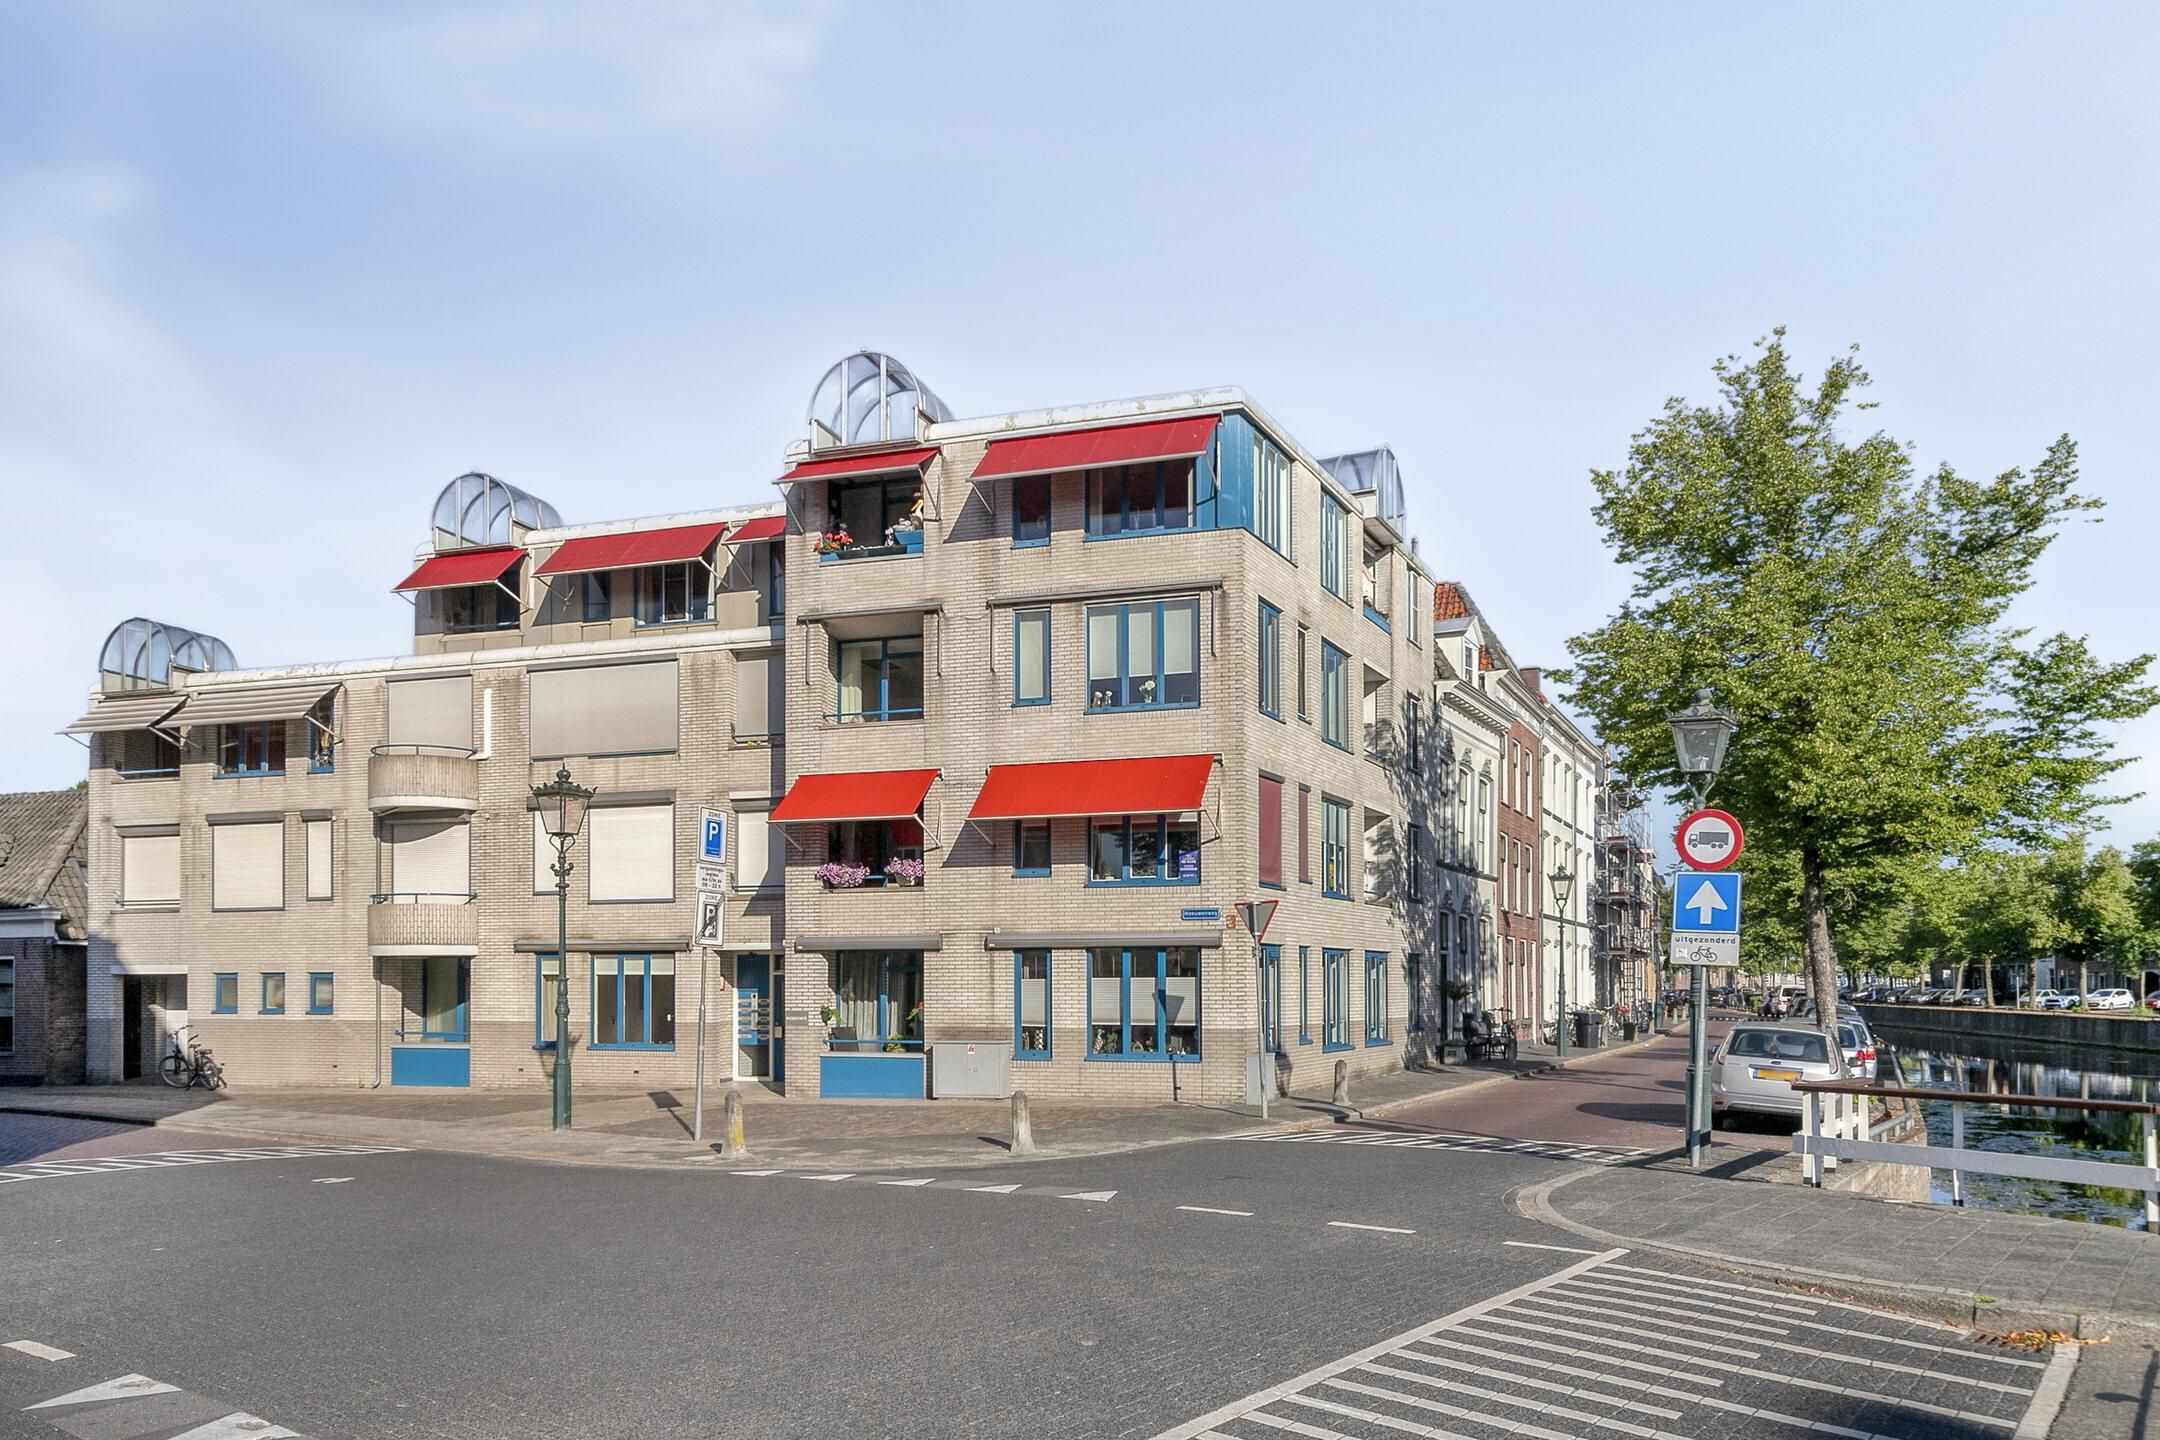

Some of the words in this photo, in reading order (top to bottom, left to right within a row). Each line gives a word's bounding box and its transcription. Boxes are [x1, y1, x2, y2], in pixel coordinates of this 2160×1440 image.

[708, 811, 721, 819] ZONE
[709, 822, 718, 840] P
[1675, 936, 1736, 944] uitgezonderd
